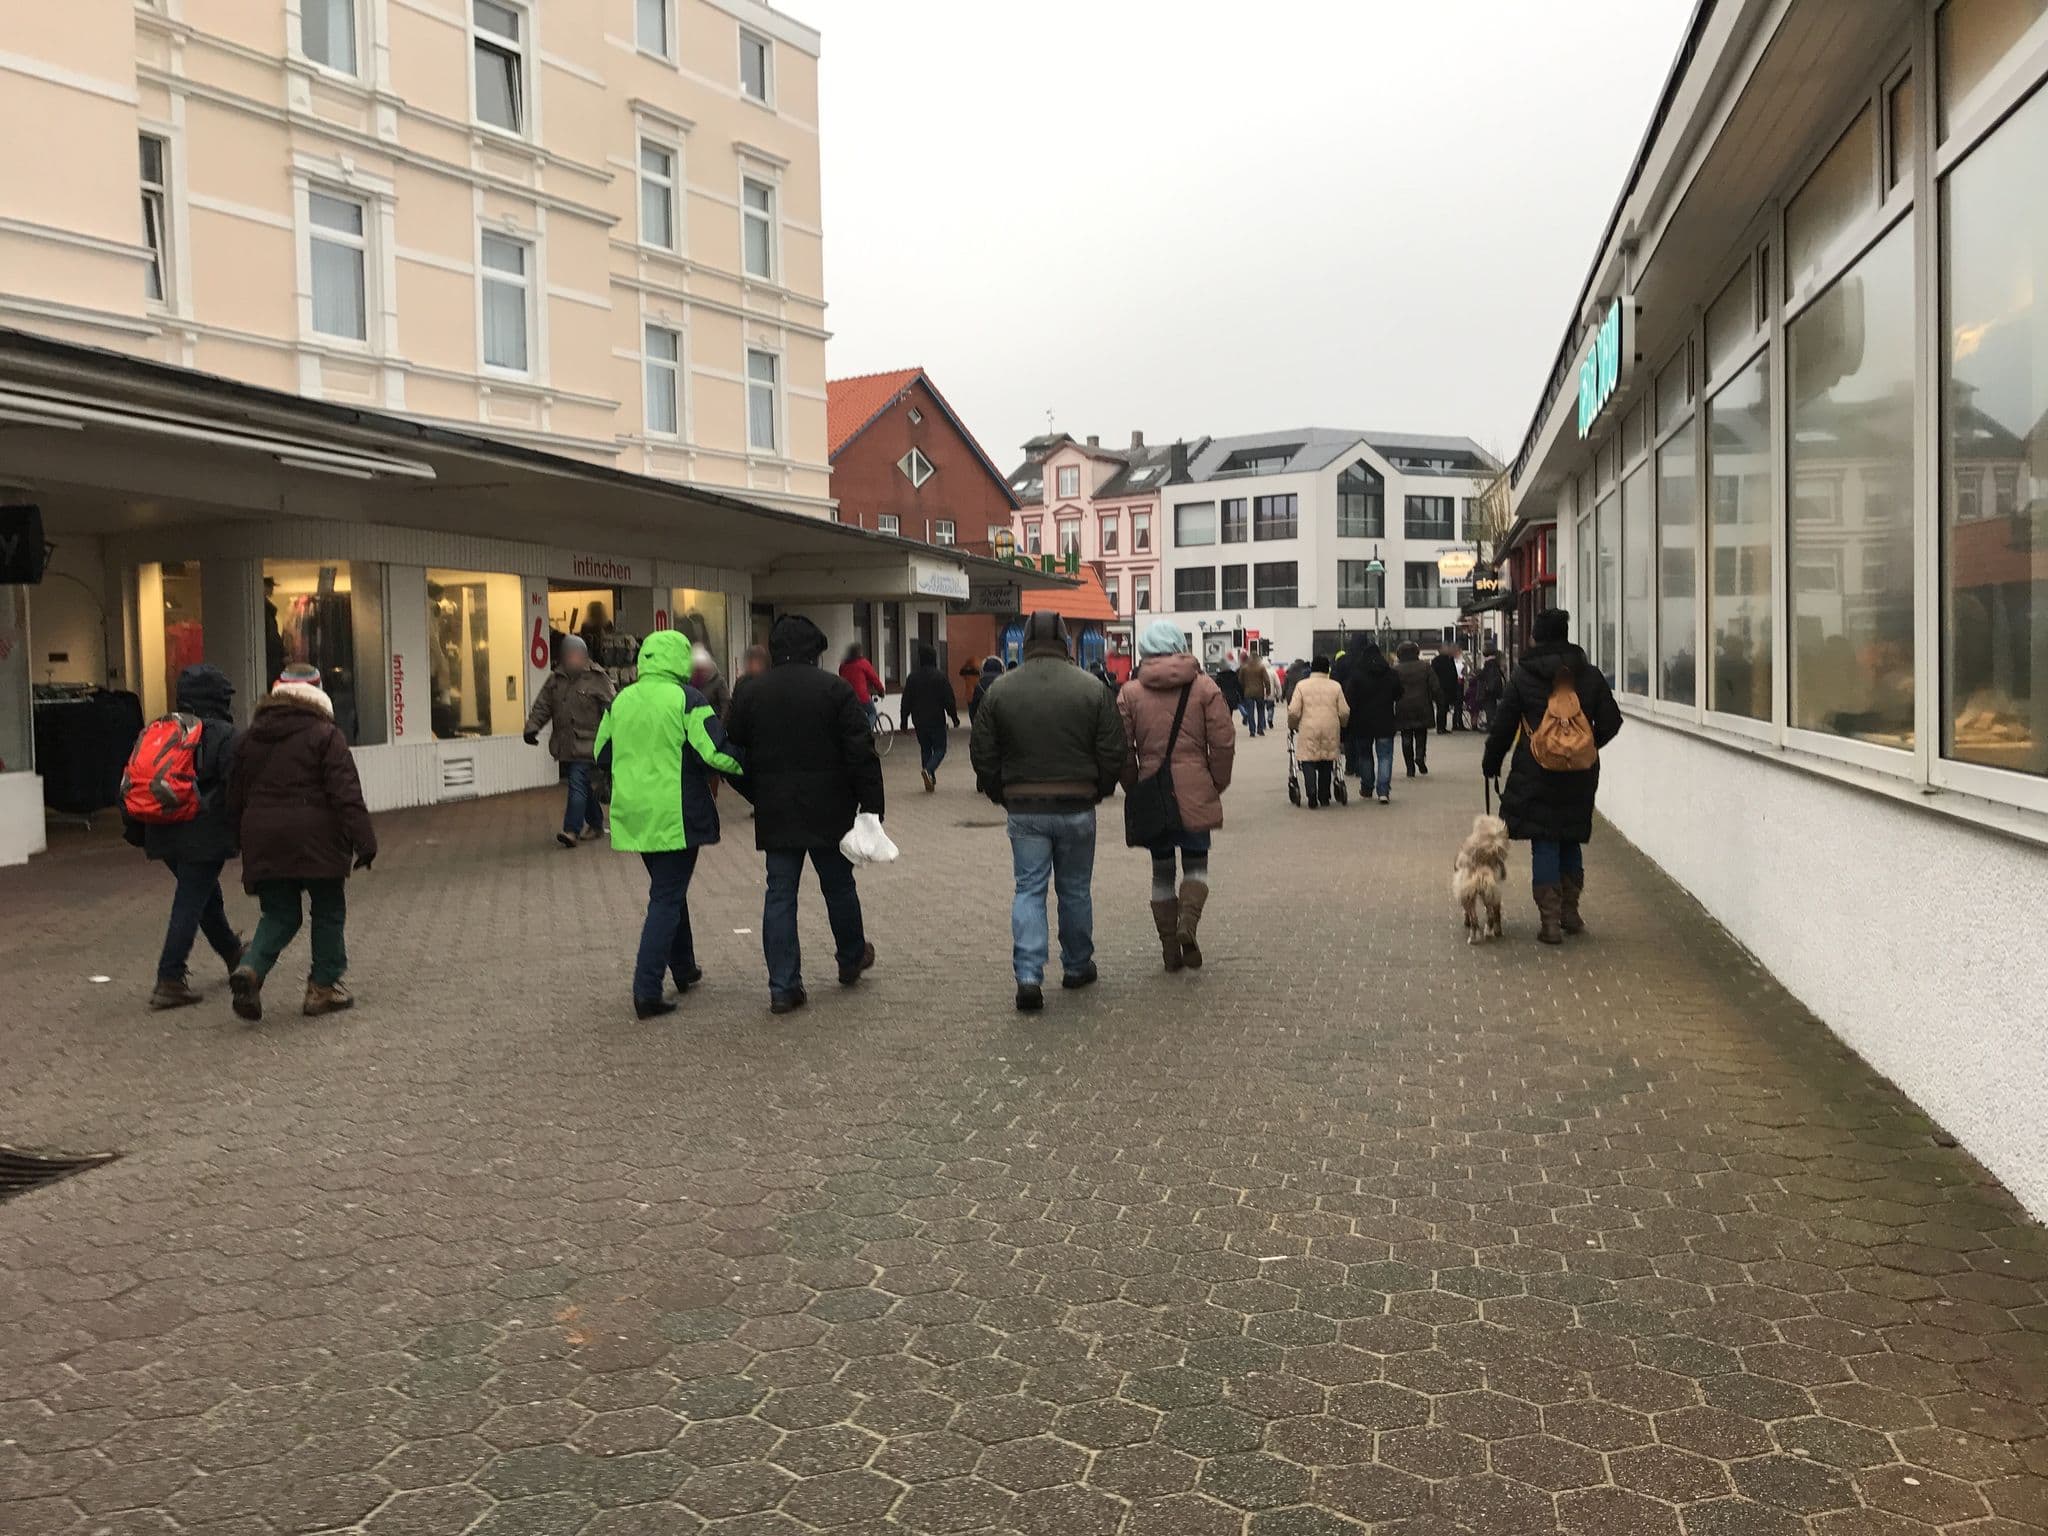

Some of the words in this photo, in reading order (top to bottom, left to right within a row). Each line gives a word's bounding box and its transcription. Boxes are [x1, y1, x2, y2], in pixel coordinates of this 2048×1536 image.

[573, 554, 631, 580] intinchen
[1476, 577, 1498, 591] sky
[531, 616, 548, 669] 6
[393, 654, 404, 736] intinchen
